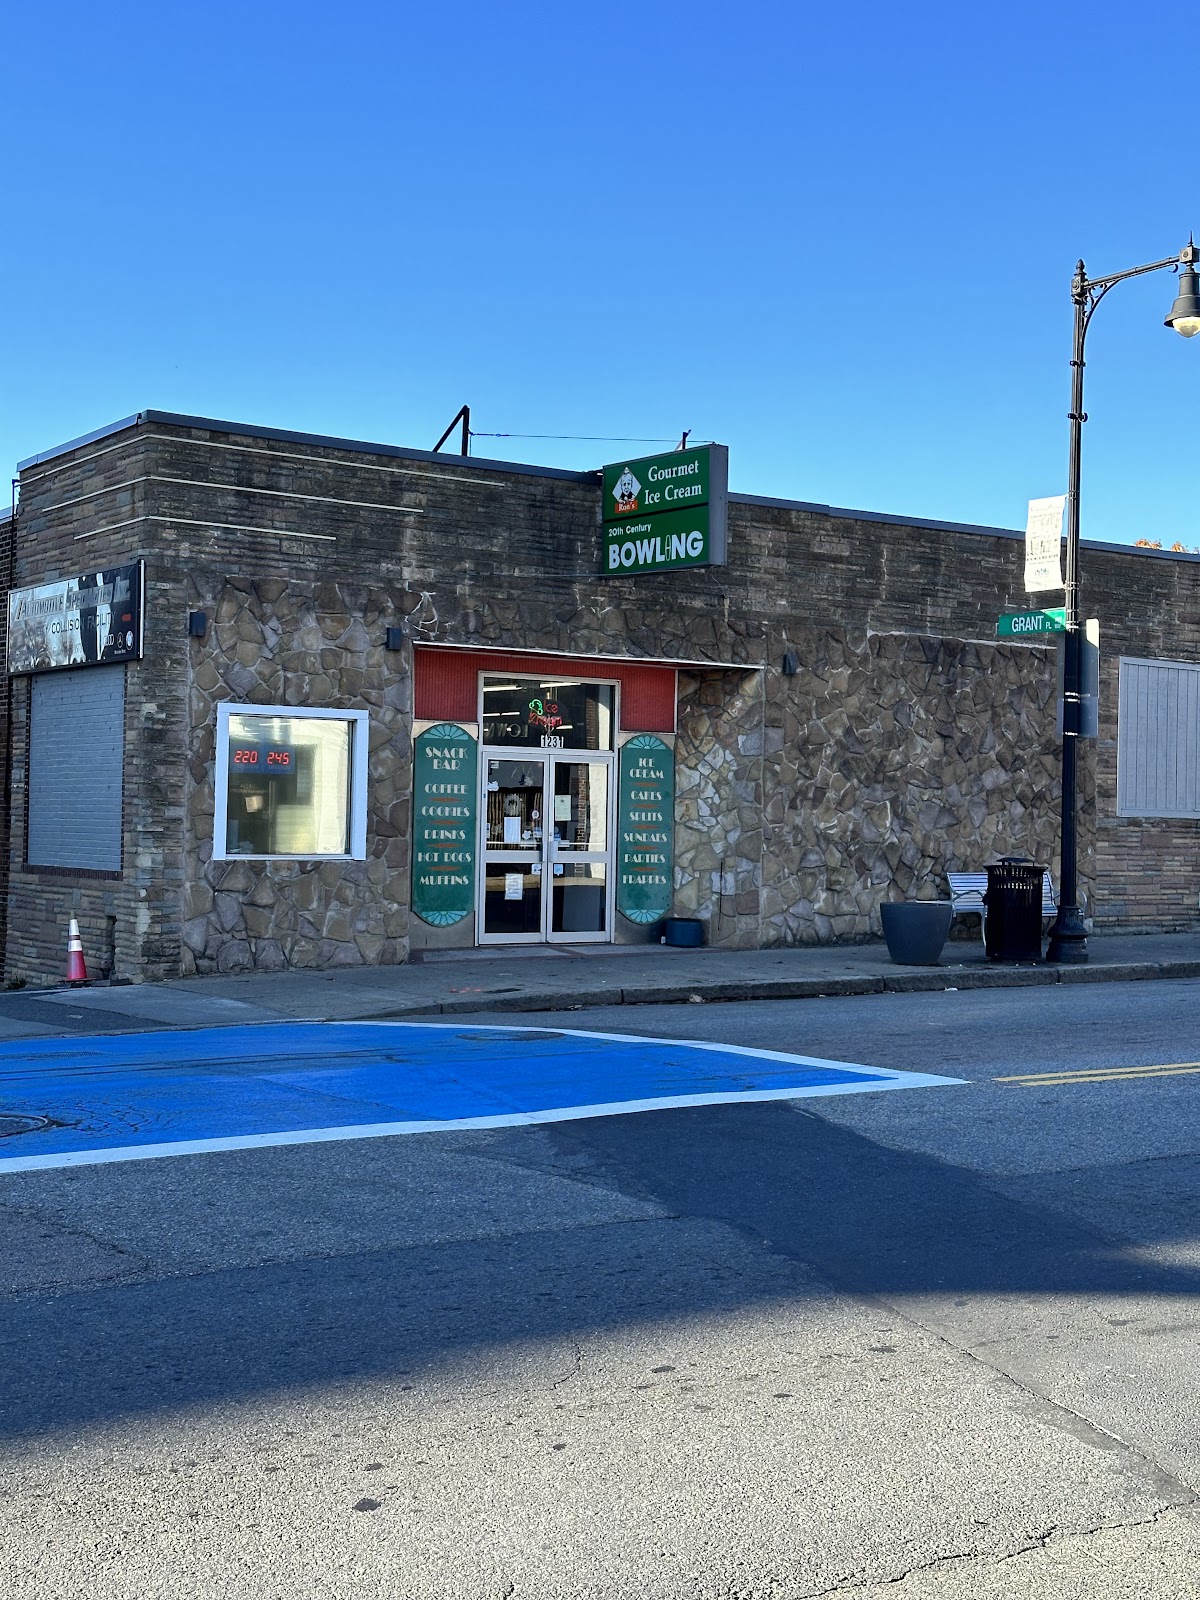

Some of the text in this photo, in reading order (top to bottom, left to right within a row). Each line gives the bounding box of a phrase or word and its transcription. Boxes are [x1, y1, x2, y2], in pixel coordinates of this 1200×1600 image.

[648, 460, 699, 482] Gourmet
[644, 484, 702, 505] Ice Cream
[618, 501, 636, 512] Ron's
[608, 523, 652, 537] 20th Century
[608, 530, 704, 570] BOWLING
[1011, 616, 1053, 633] GRANT PL
[541, 735, 564, 749] 1231
[234, 750, 290, 765] 220 245
[425, 746, 468, 759] SNACK
[433, 758, 461, 771] BAR
[639, 757, 655, 768] ICE
[629, 768, 665, 779] CREAM
[424, 783, 468, 795] COFFEE
[631, 790, 662, 801] CAKES
[421, 805, 470, 817] COOKIES
[629, 811, 663, 822] SPLITS
[424, 829, 466, 840] DRINKS
[623, 832, 668, 843] SUNDAES
[417, 852, 472, 863] HOT DOGS
[624, 853, 666, 864] PARTIES
[419, 875, 469, 886] MUFFINS
[622, 875, 667, 885] FRAPPES
